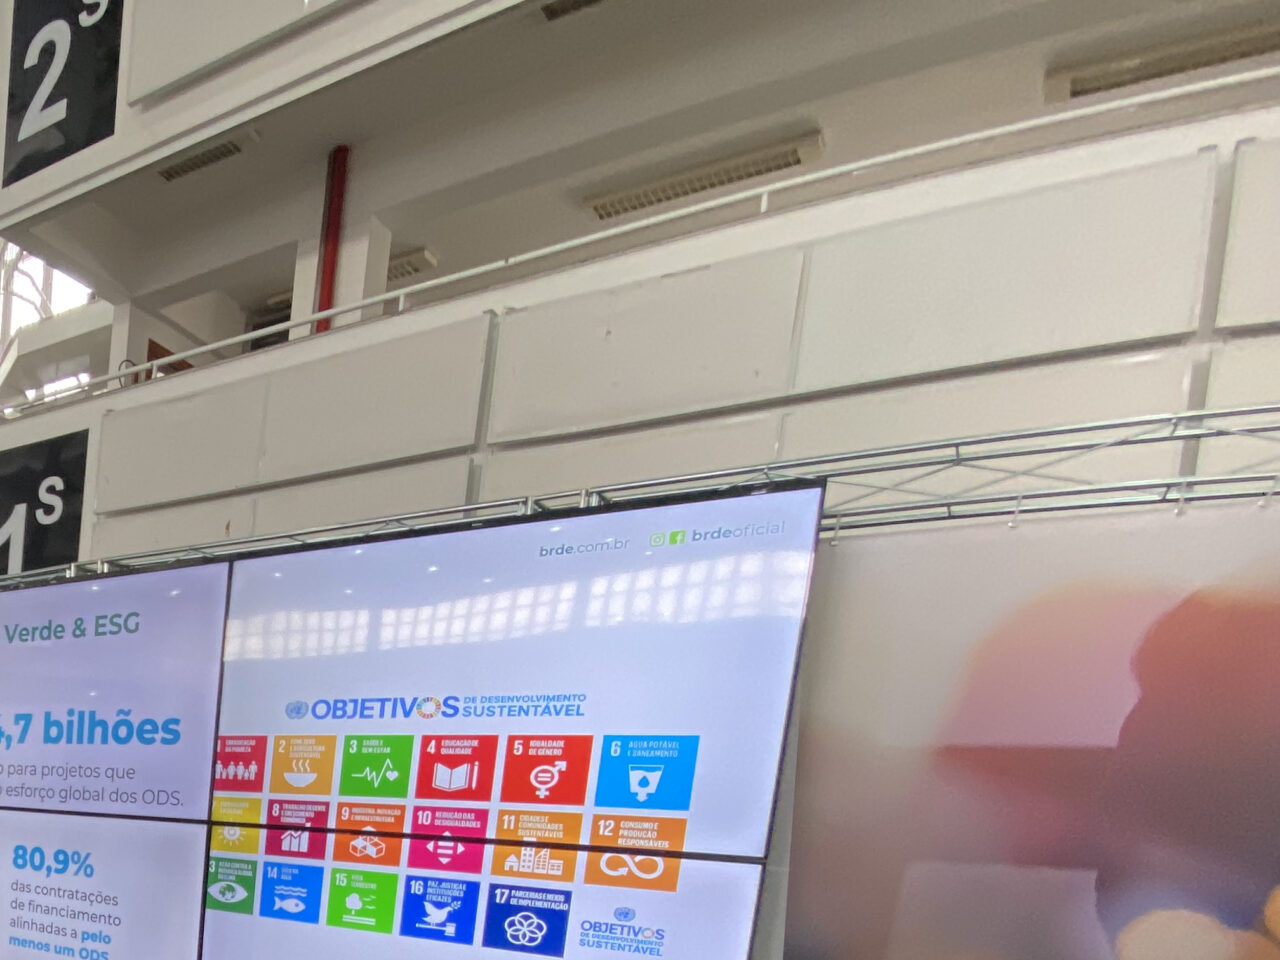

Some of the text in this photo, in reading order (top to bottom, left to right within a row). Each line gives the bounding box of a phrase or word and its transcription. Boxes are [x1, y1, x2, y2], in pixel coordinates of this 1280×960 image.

[539, 520, 786, 558] brde.com.br brdeoficial
[4, 619, 65, 644] Verde
[71, 617, 86, 639] &
[94, 611, 140, 637] ESG
[463, 694, 587, 704] DE DESENVOLVIMENTO
[311, 695, 460, 720] OBJETIVOS
[462, 702, 585, 718] SUSTENTÁVEL
[43, 708, 182, 746] bilhões
[278, 740, 286, 753] 2
[350, 740, 357, 754] 3
[427, 740, 436, 754] 4
[513, 740, 523, 755] 5
[529, 740, 565, 748] IGUALDADE
[610, 741, 621, 757] 6
[7, 763, 37, 781] para
[41, 761, 101, 781] projetos
[104, 766, 136, 785] que
[6, 781, 55, 803] esforço
[59, 785, 105, 804] global
[109, 788, 138, 805] dos
[141, 788, 185, 807] ODS.
[272, 803, 279, 817] 8
[341, 807, 349, 821] 9
[417, 811, 430, 825] 10
[502, 815, 515, 829] 11
[621, 821, 652, 829] CONSUMO
[598, 819, 614, 836] 12
[619, 829, 657, 838] PRODUÇÃO
[618, 837, 669, 849] RESPONSÁVEIS
[13, 844, 95, 878] 80,9%
[267, 866, 278, 880] 14
[335, 873, 347, 886] 15
[10, 879, 119, 907] das contratações
[410, 880, 423, 895] 16
[494, 889, 510, 903] 17
[10, 897, 122, 927] de financiamento
[9, 916, 112, 945] alinhadas a pelo
[581, 920, 665, 940] OBJETIVOS
[8, 936, 51, 952] menos
[54, 944, 75, 957] um
[579, 938, 663, 957] SUSTENTÁVEL
